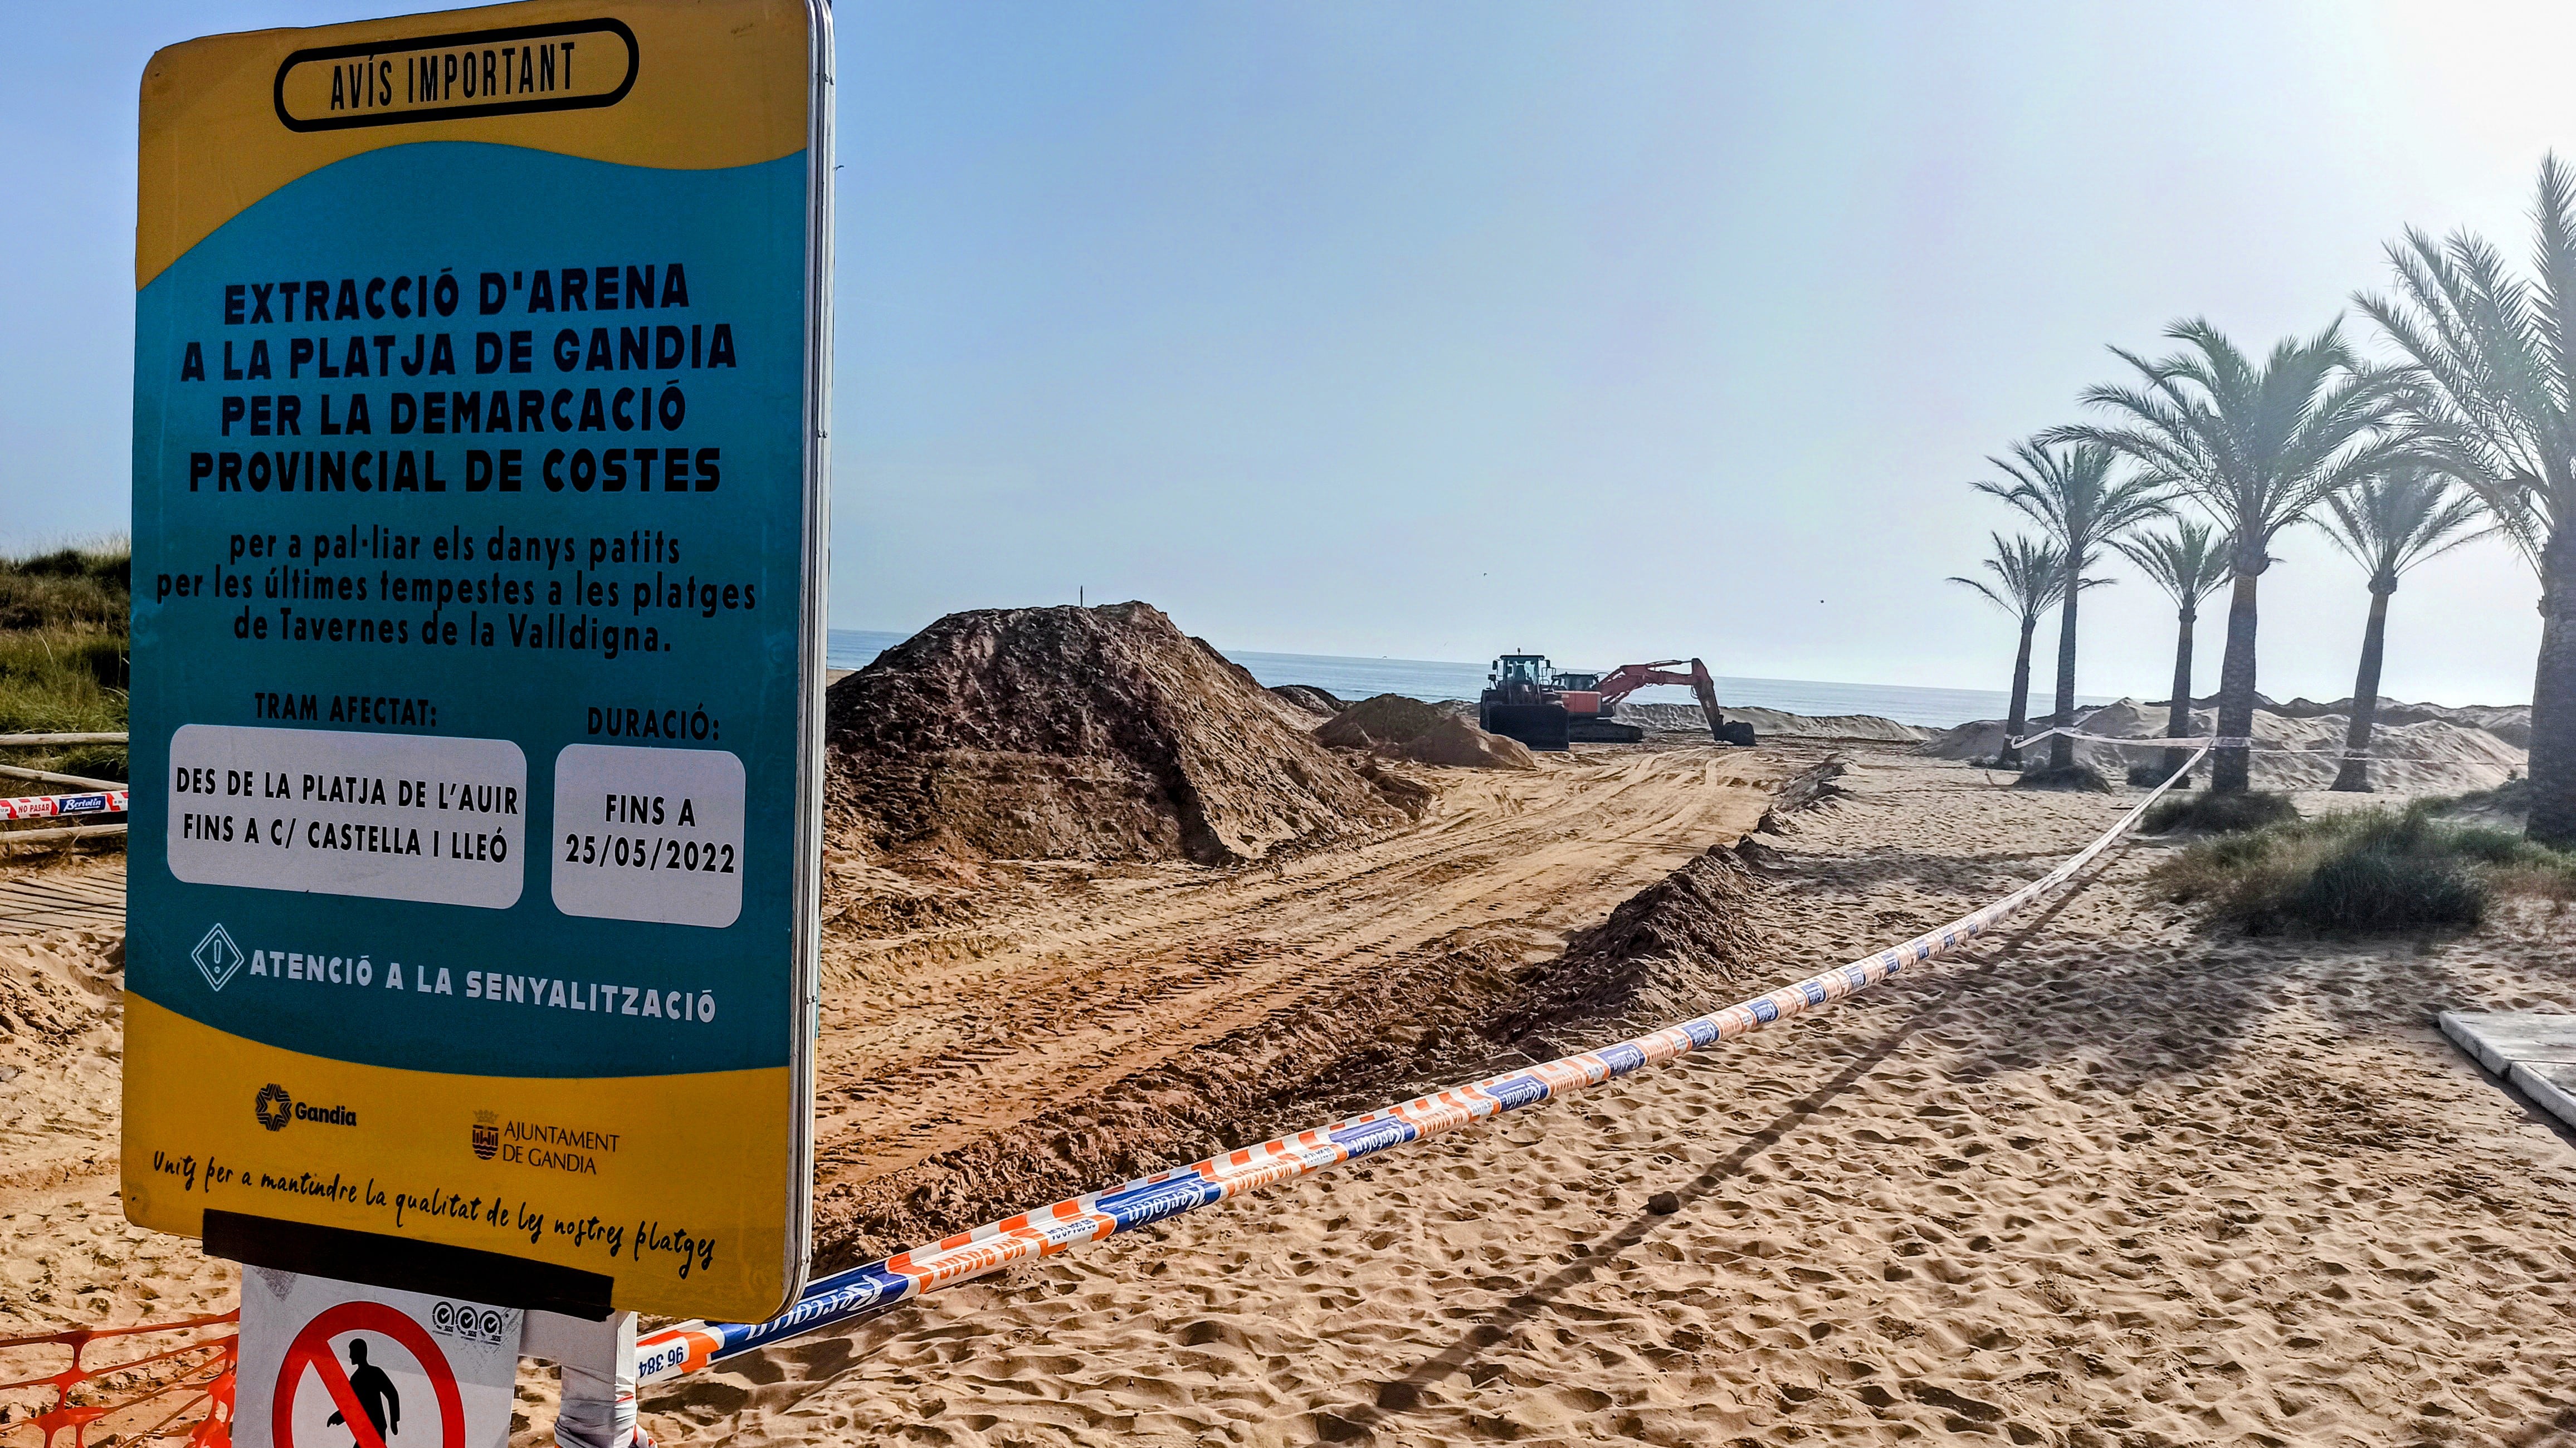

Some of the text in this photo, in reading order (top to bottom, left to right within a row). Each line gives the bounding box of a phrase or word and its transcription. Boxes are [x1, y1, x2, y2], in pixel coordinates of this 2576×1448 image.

[331, 42, 576, 110] AVÍS IMPORTANT
[225, 263, 689, 325] EXTRACCIÓ D'ARENA
[181, 324, 736, 381] A LA PLATJA DE GANDIA
[222, 380, 685, 436] PER LA DEMARCACIÓ
[191, 448, 720, 492] PROVINCIAL DE COSTES
[231, 535, 276, 565] per
[289, 535, 300, 557] a
[433, 525, 474, 560] els
[487, 526, 574, 570] danys
[590, 530, 679, 568] patits
[157, 564, 755, 618] per les últimes tempestes a les platges
[235, 605, 670, 659] de Tavernes de la Valldigna.
[255, 693, 436, 727] TRAM AFECTAT:
[588, 703, 719, 740] DURACIÓ:
[30, 804, 50, 812] PASAR
[177, 767, 215, 794] DES
[228, 770, 252, 796] DE
[265, 772, 290, 799] LA
[303, 775, 386, 805] PLATJA
[399, 780, 425, 808] DE
[606, 795, 695, 826] FINS A
[184, 814, 506, 862] FINS A C/ CASTELLA I LLEÓ
[566, 834, 734, 873] 25/05/2022
[250, 950, 715, 1023] ATENCIÓ A LA SENYALITZACIÓ
[295, 1102, 357, 1126] Gandia
[503, 1120, 620, 1153] AJUNTAMENT
[503, 1144, 597, 1175] DE GANDIA
[205, 1156, 233, 1193] per
[242, 1171, 252, 1186] a
[261, 1172, 357, 1202] mantindre
[366, 1178, 387, 1206] la
[396, 1188, 482, 1227] qualitat
[486, 1197, 509, 1227] de
[518, 1202, 544, 1244] les
[554, 1216, 624, 1257] nostres
[633, 1220, 716, 1280] platges
[639, 1346, 684, 1378] 96 384
